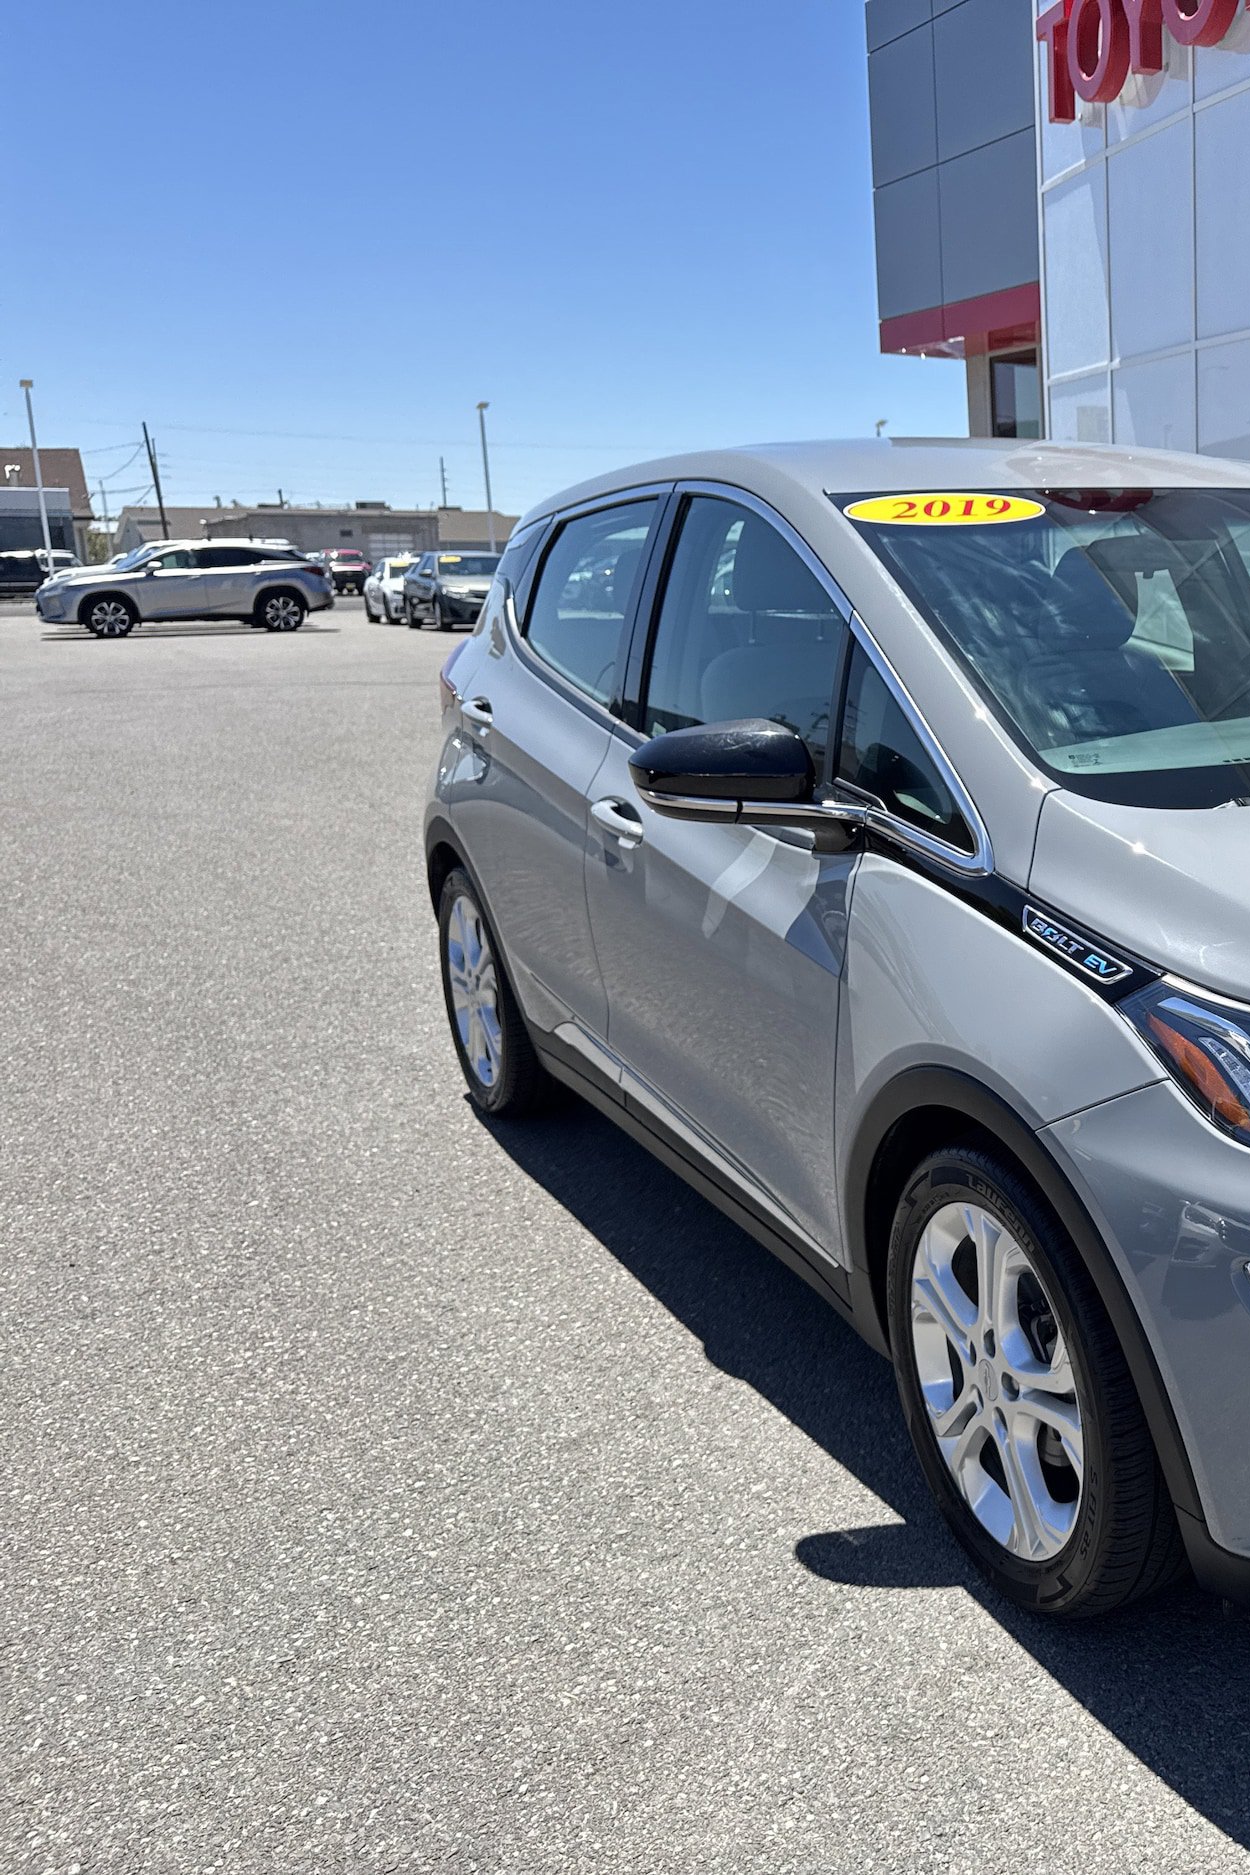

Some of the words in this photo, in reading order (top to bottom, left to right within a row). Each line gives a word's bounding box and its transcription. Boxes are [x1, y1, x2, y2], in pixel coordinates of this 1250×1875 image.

[893, 500, 1011, 519] 2019
[1030, 918, 1084, 954] BOLT
[1083, 953, 1117, 974] EV
